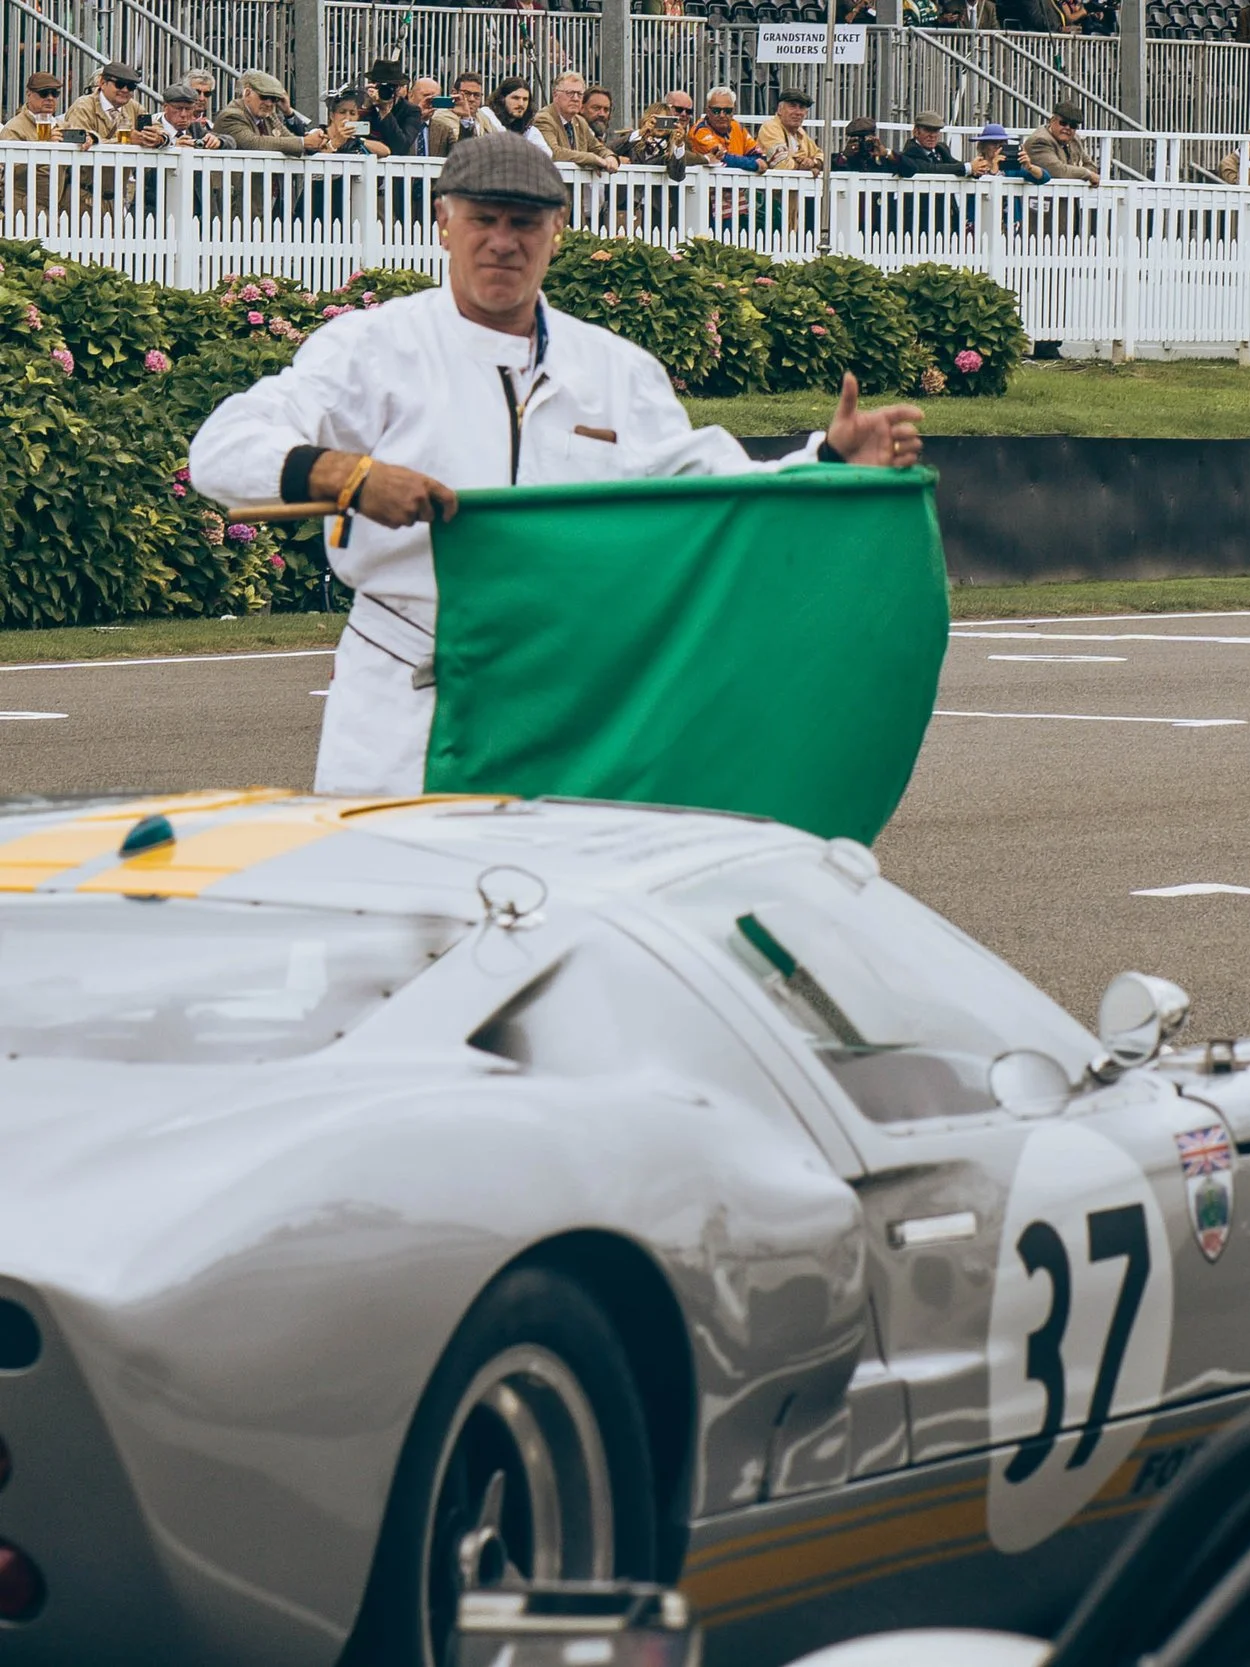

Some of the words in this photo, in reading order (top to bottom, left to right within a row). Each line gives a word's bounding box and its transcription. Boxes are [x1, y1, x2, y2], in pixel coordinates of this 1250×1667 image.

[763, 33, 826, 42] GRANDSTAND
[832, 33, 861, 43] ICKET
[776, 45, 819, 54] HOLDERS
[821, 46, 846, 55] OLY
[1003, 1203, 1152, 1484] 37
